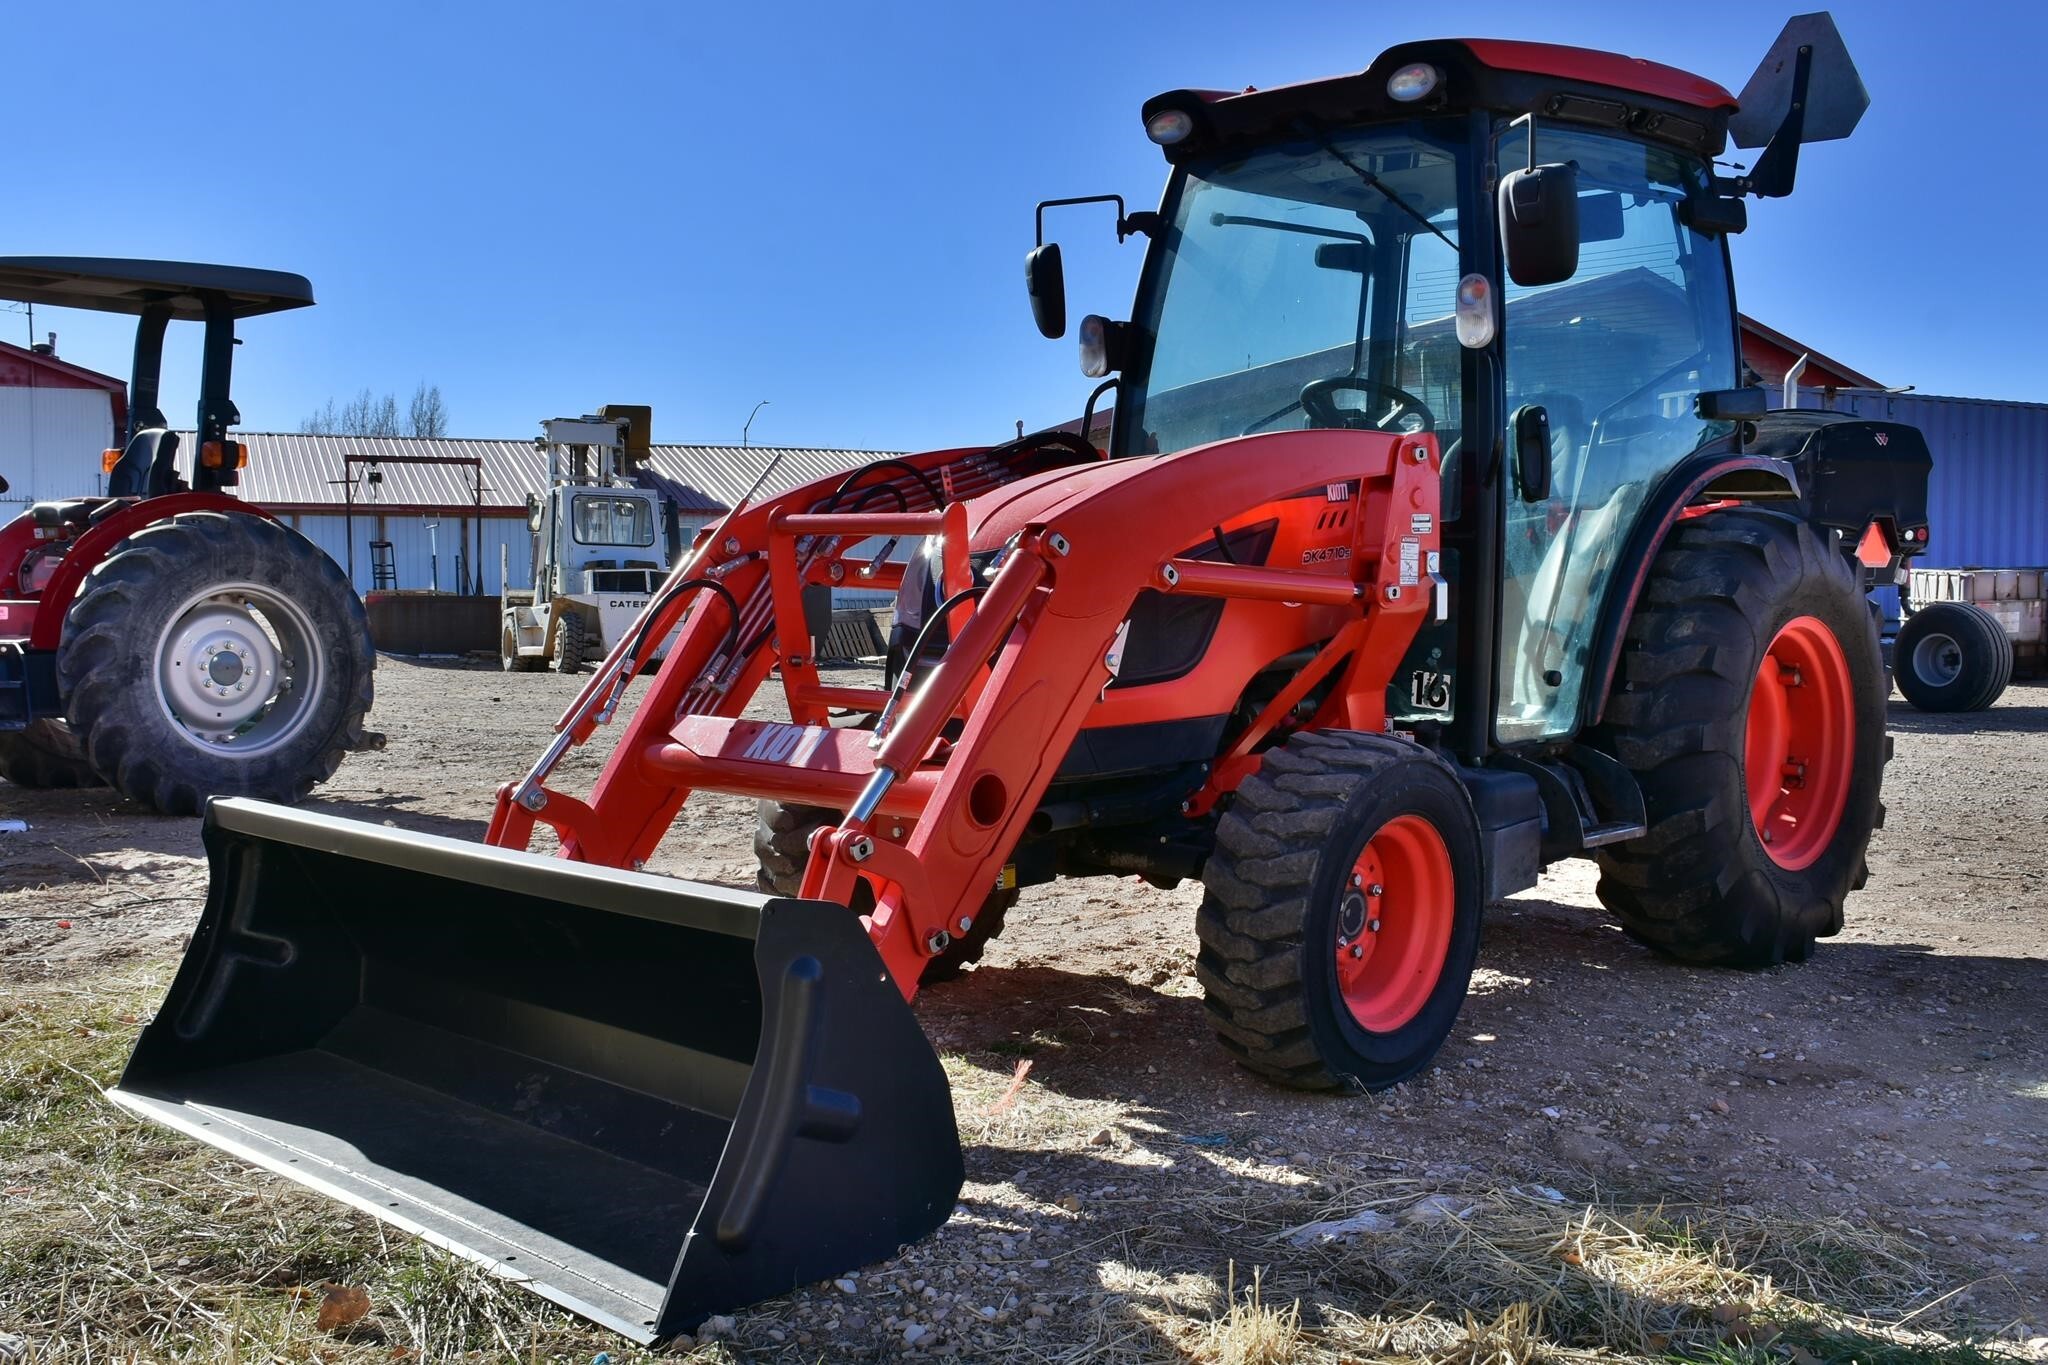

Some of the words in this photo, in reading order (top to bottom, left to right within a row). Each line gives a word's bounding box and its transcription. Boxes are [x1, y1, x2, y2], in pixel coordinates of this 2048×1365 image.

[1327, 483, 1349, 502] KIOTI
[1412, 670, 1448, 709] 16
[742, 723, 830, 768] KIOTI
